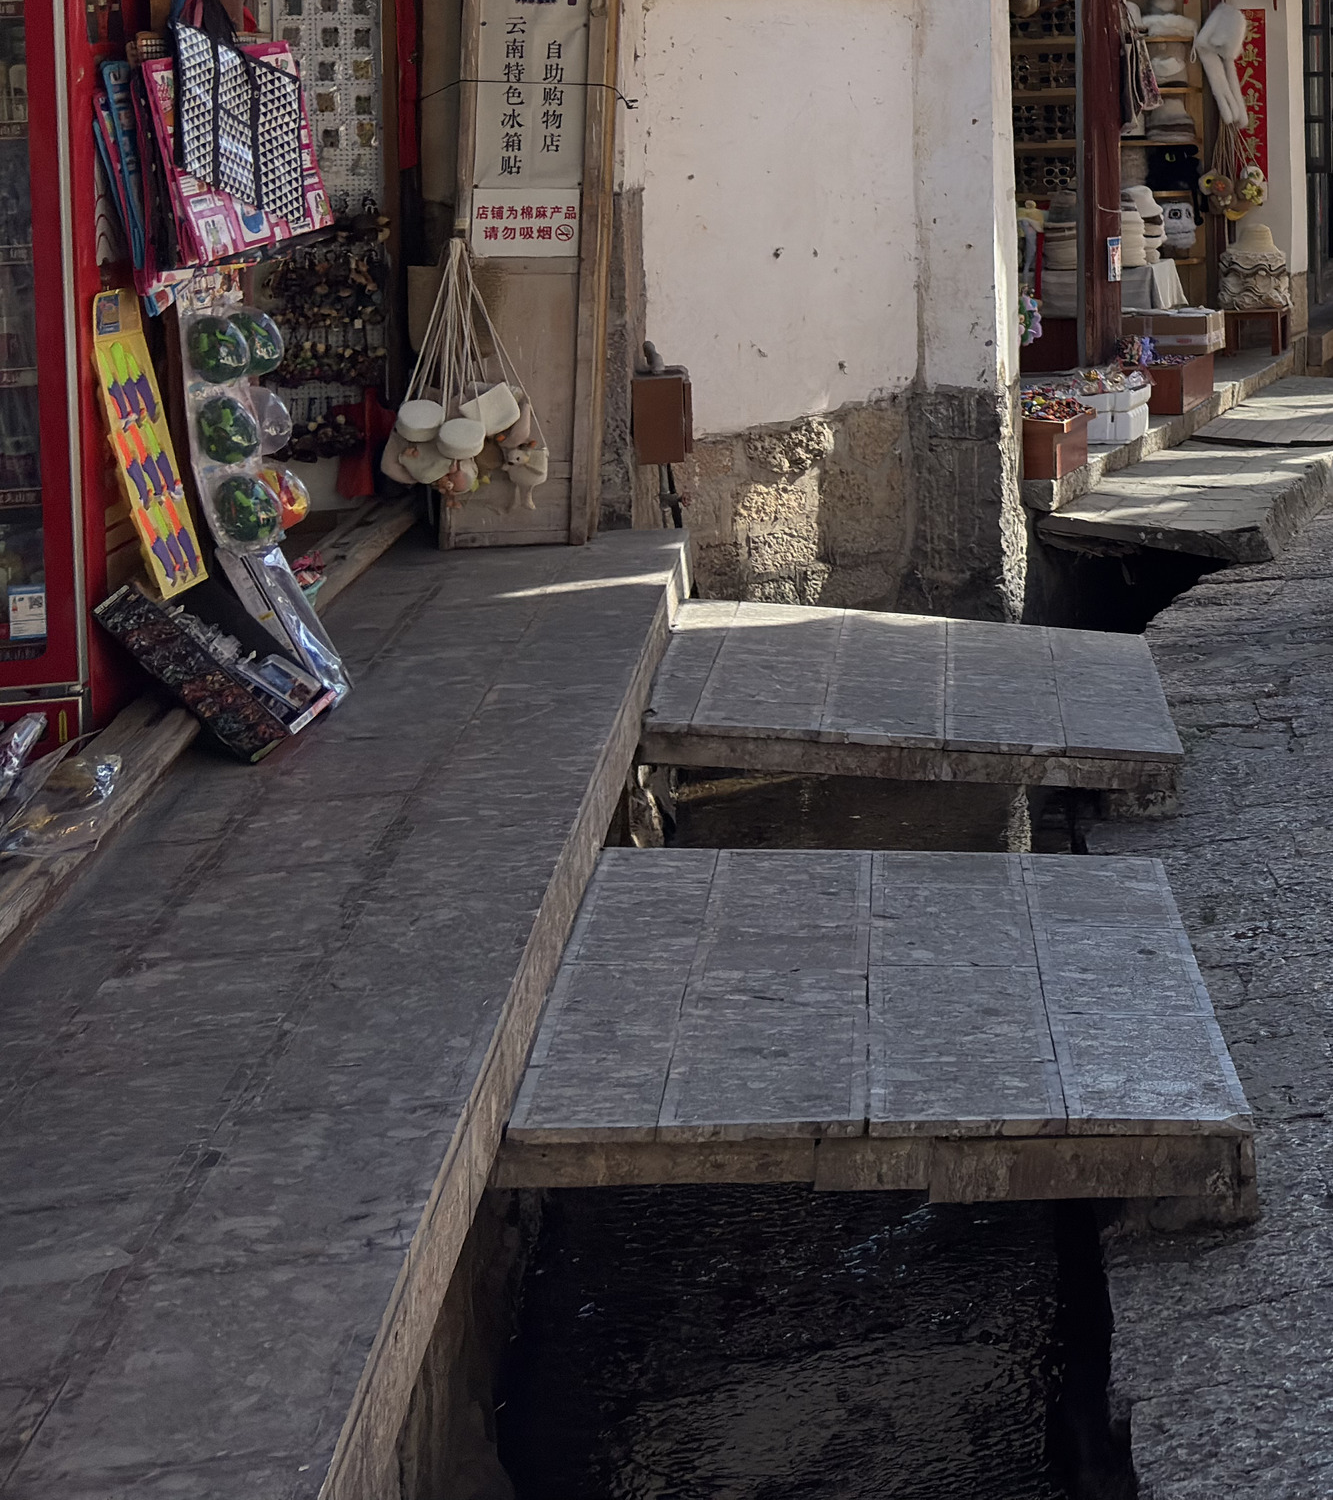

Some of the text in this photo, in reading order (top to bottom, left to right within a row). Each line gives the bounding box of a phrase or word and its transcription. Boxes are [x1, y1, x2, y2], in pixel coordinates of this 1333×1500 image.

[498, 15, 527, 177] 云南特色冰箱贴
[540, 40, 564, 153] 自助购物店
[475, 205, 577, 221] 店铺为棉麻产品
[483, 225, 553, 241] 请勿吸烟
